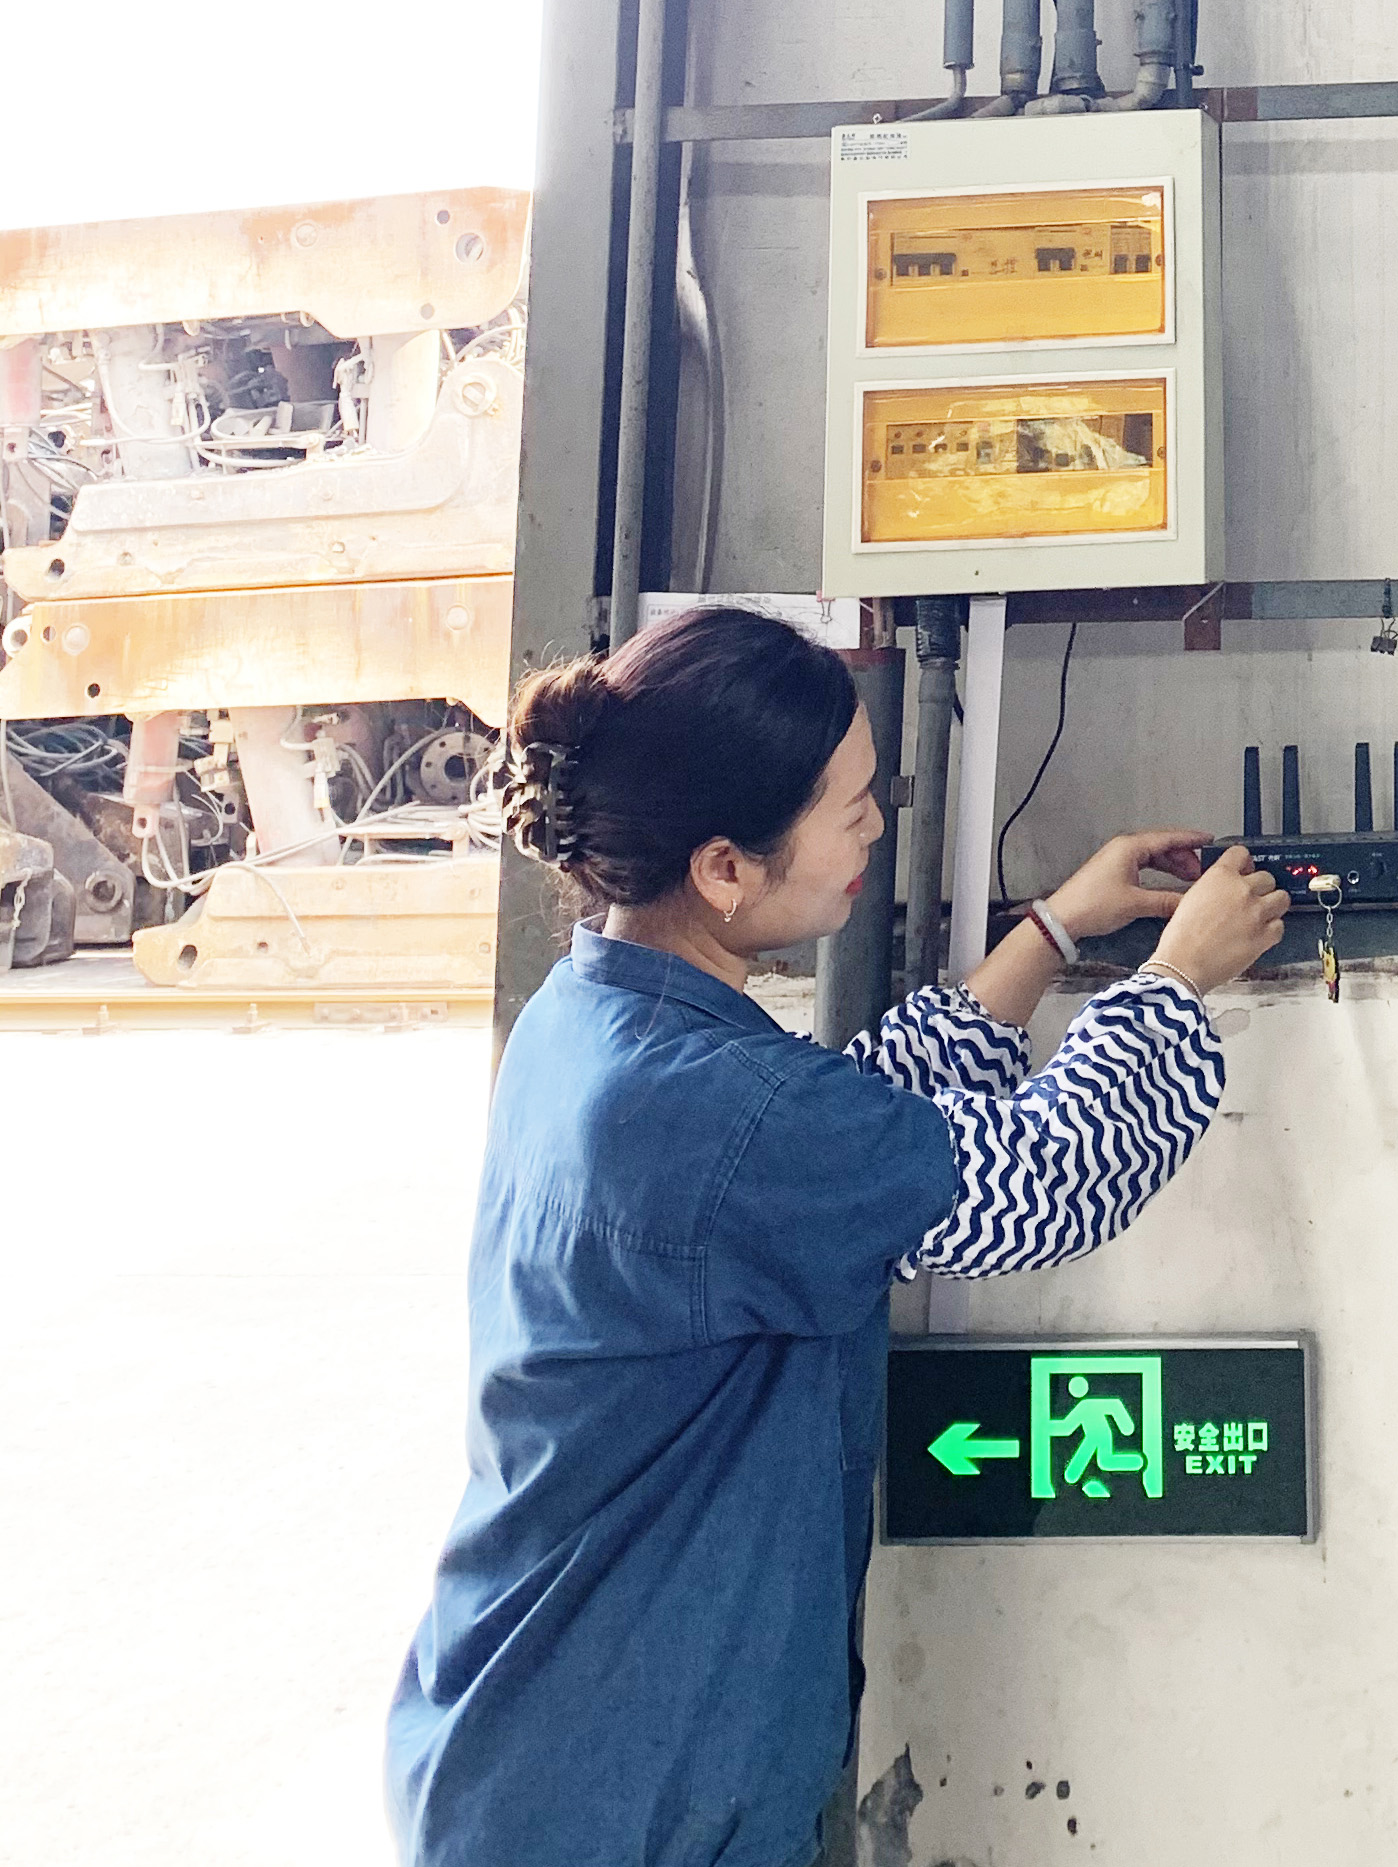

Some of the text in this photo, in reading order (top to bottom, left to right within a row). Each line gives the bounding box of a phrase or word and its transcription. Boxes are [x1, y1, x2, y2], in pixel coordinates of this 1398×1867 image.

[1173, 1421, 1268, 1452] 安全出口
[1185, 1455, 1258, 1475] EXIT
